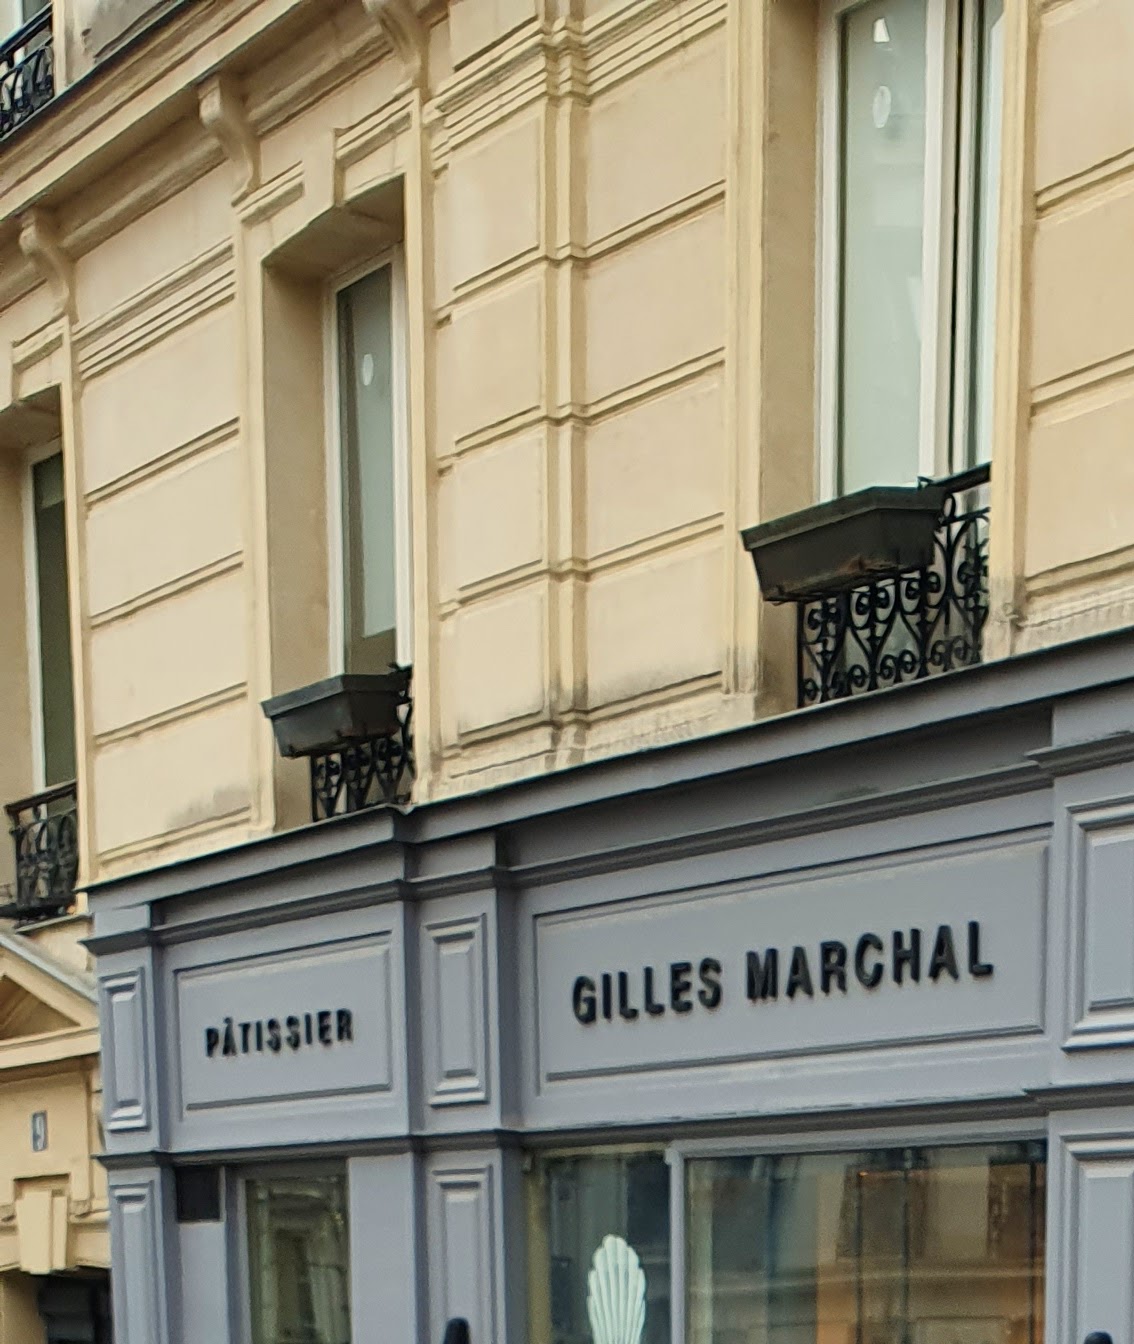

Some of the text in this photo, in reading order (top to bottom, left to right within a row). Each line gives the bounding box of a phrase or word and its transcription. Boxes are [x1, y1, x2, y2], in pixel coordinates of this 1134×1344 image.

[571, 920, 995, 1025] GILLES MARCHAL
[205, 1007, 354, 1058] PÂTISSIER
